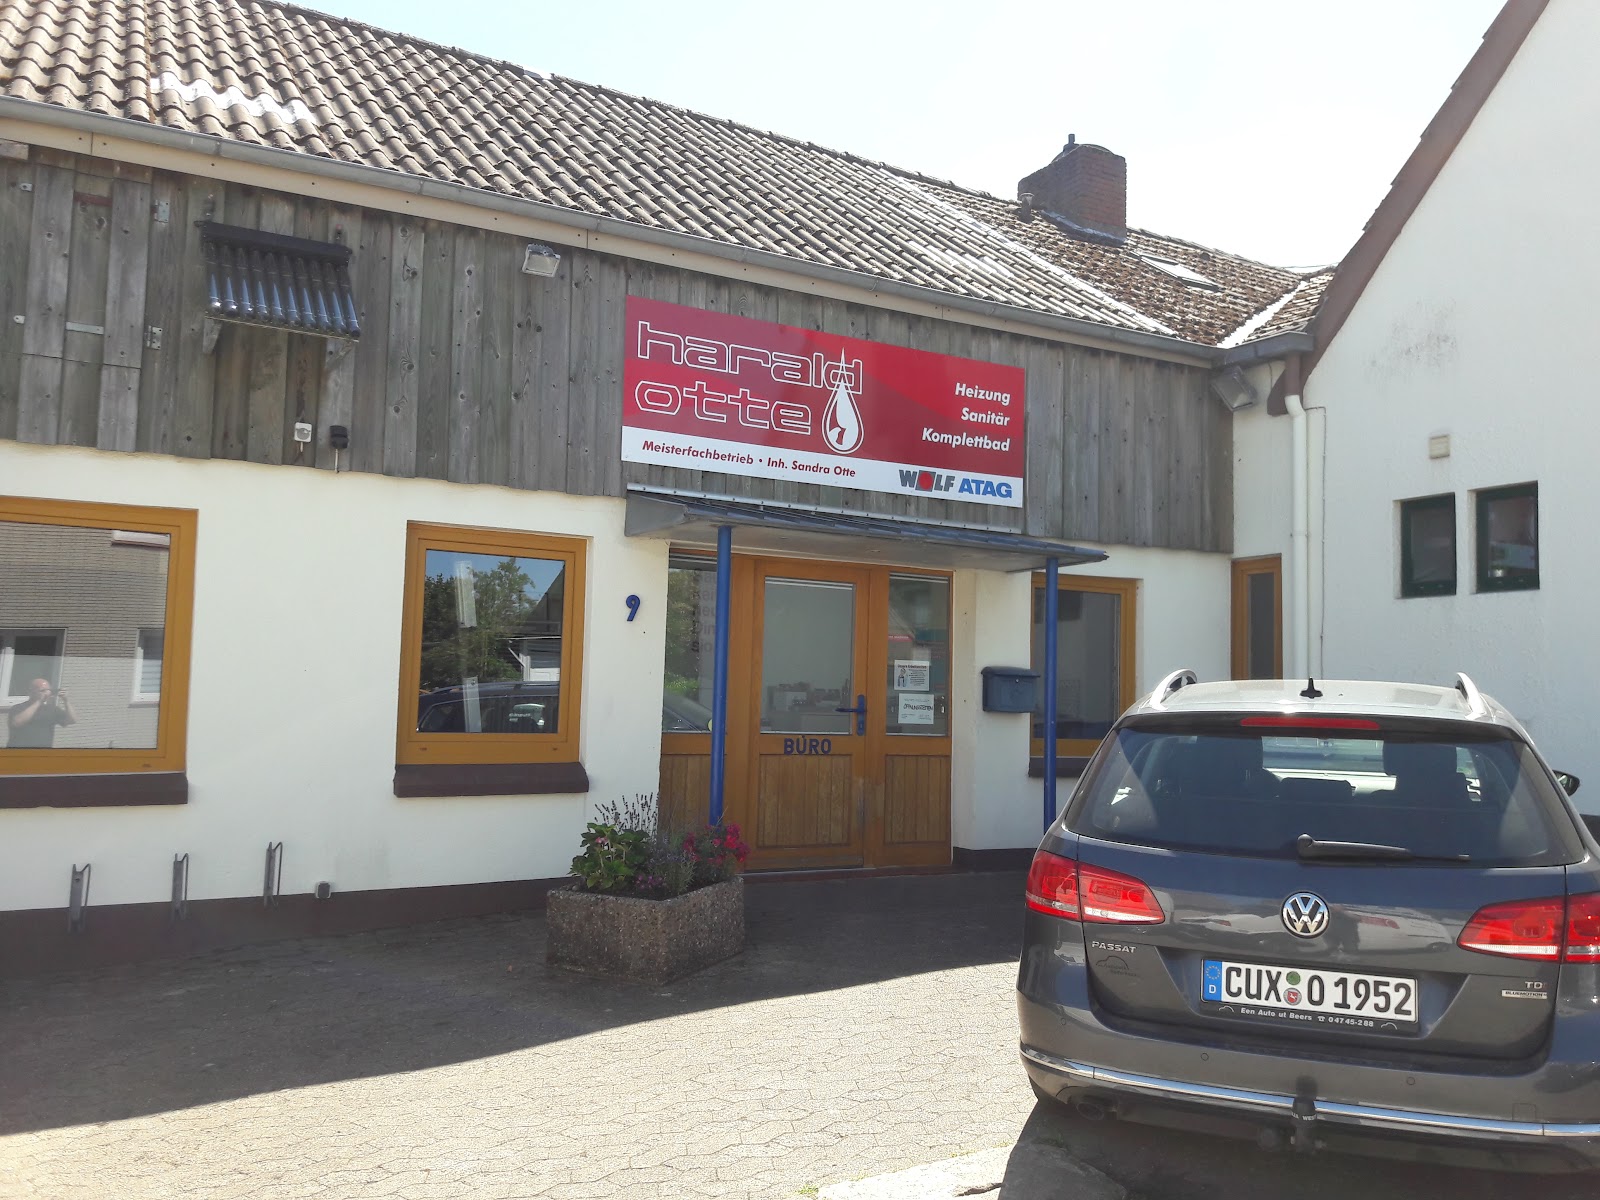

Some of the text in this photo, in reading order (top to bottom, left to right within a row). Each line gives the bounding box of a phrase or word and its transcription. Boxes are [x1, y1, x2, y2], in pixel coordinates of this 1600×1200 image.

[637, 320, 863, 395] harald
[955, 382, 1011, 406] Heizung
[635, 380, 811, 436] otte
[961, 407, 1010, 426] Sanitär
[922, 427, 1010, 452] Komplettbad
[642, 440, 856, 478] Meisterfachbetrieb Inh. Sandra Otte
[899, 469, 956, 493] WOLF
[958, 477, 1013, 499] ATAG
[625, 594, 641, 622] 9
[783, 735, 832, 756] BÜRO
[1092, 940, 1137, 954] PASSAT
[1208, 984, 1217, 995] D
[1225, 966, 1283, 1003] CUX
[1333, 978, 1413, 1016] 1952
[1240, 1007, 1256, 1015] Een
[1258, 1009, 1276, 1018] Auto
[1289, 1012, 1313, 1021] Beers
